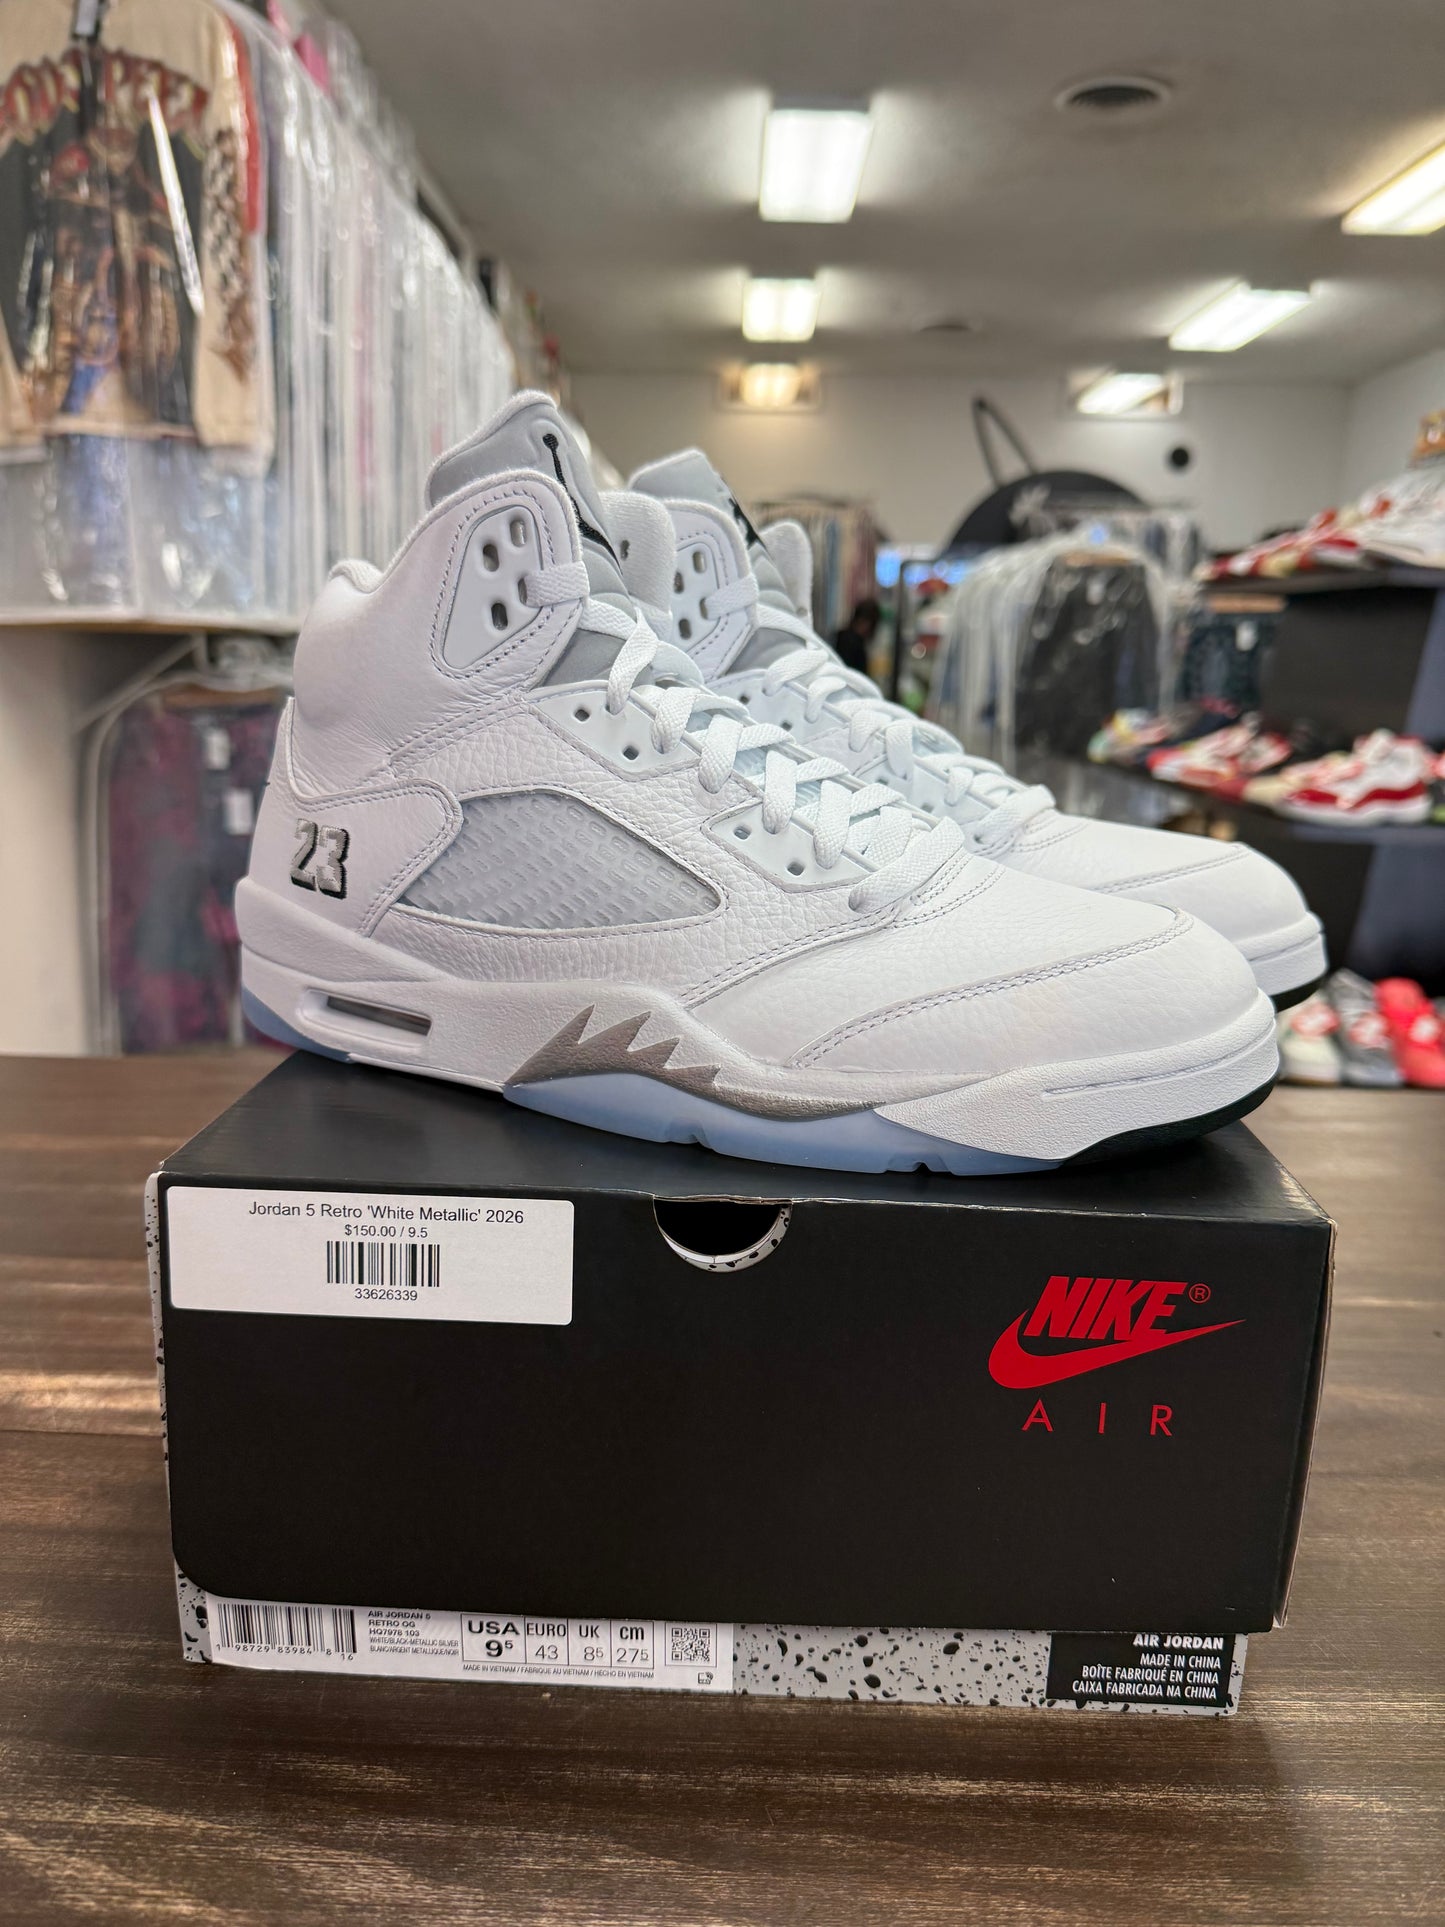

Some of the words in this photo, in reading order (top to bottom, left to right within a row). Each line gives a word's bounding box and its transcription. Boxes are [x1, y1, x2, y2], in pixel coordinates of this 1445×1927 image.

[290, 818, 350, 900] 23
[249, 1201, 301, 1216] Jordan
[306, 1203, 315, 1217] 5
[321, 1204, 362, 1218] Retro
[367, 1205, 414, 1219] 'White
[419, 1207, 481, 1222] Metallic'
[486, 1210, 524, 1224] 2026
[344, 1224, 396, 1237] $150.00
[400, 1226, 405, 1237] /
[408, 1227, 428, 1238] 9.5
[354, 1288, 417, 1301] 33626339
[1021, 1398, 1173, 1437] AIR
[385, 1611, 423, 1619] JORDAN
[368, 1619, 400, 1627] RETRO
[402, 1620, 415, 1628] OG
[468, 1620, 520, 1635] USA
[526, 1622, 566, 1637] EURO
[369, 1628, 403, 1636] HQ7978
[405, 1629, 420, 1637] 103
[579, 1624, 600, 1639] UK
[619, 1626, 645, 1640] cm
[438, 1639, 459, 1647] SILVER
[1132, 1633, 1160, 1648] AIR
[1163, 1635, 1224, 1650] JORDAN
[235, 1644, 270, 1653] 98729
[278, 1645, 312, 1655] 83984
[326, 1648, 332, 1656] 8
[535, 1644, 559, 1659] 43
[1139, 1653, 1171, 1667] MADE
[1173, 1654, 1186, 1668] IN
[1188, 1655, 1221, 1669] CHINA
[482, 1664, 489, 1672] IN
[490, 1665, 516, 1673] VIETNAM
[521, 1666, 552, 1674] FABRIQUE
[562, 1668, 589, 1676] VIETNAM
[617, 1670, 626, 1678] EN
[627, 1671, 654, 1679] VIETNAM
[1082, 1663, 1112, 1680] BOÎTE
[1114, 1666, 1167, 1682] FABRIQUÉ
[1169, 1670, 1183, 1683] EN
[1186, 1671, 1219, 1684] CHINA
[1072, 1680, 1103, 1695] CAIXA
[1106, 1682, 1163, 1697] FABRICADA
[1166, 1684, 1181, 1698] NA
[1184, 1685, 1217, 1700] CHINA
